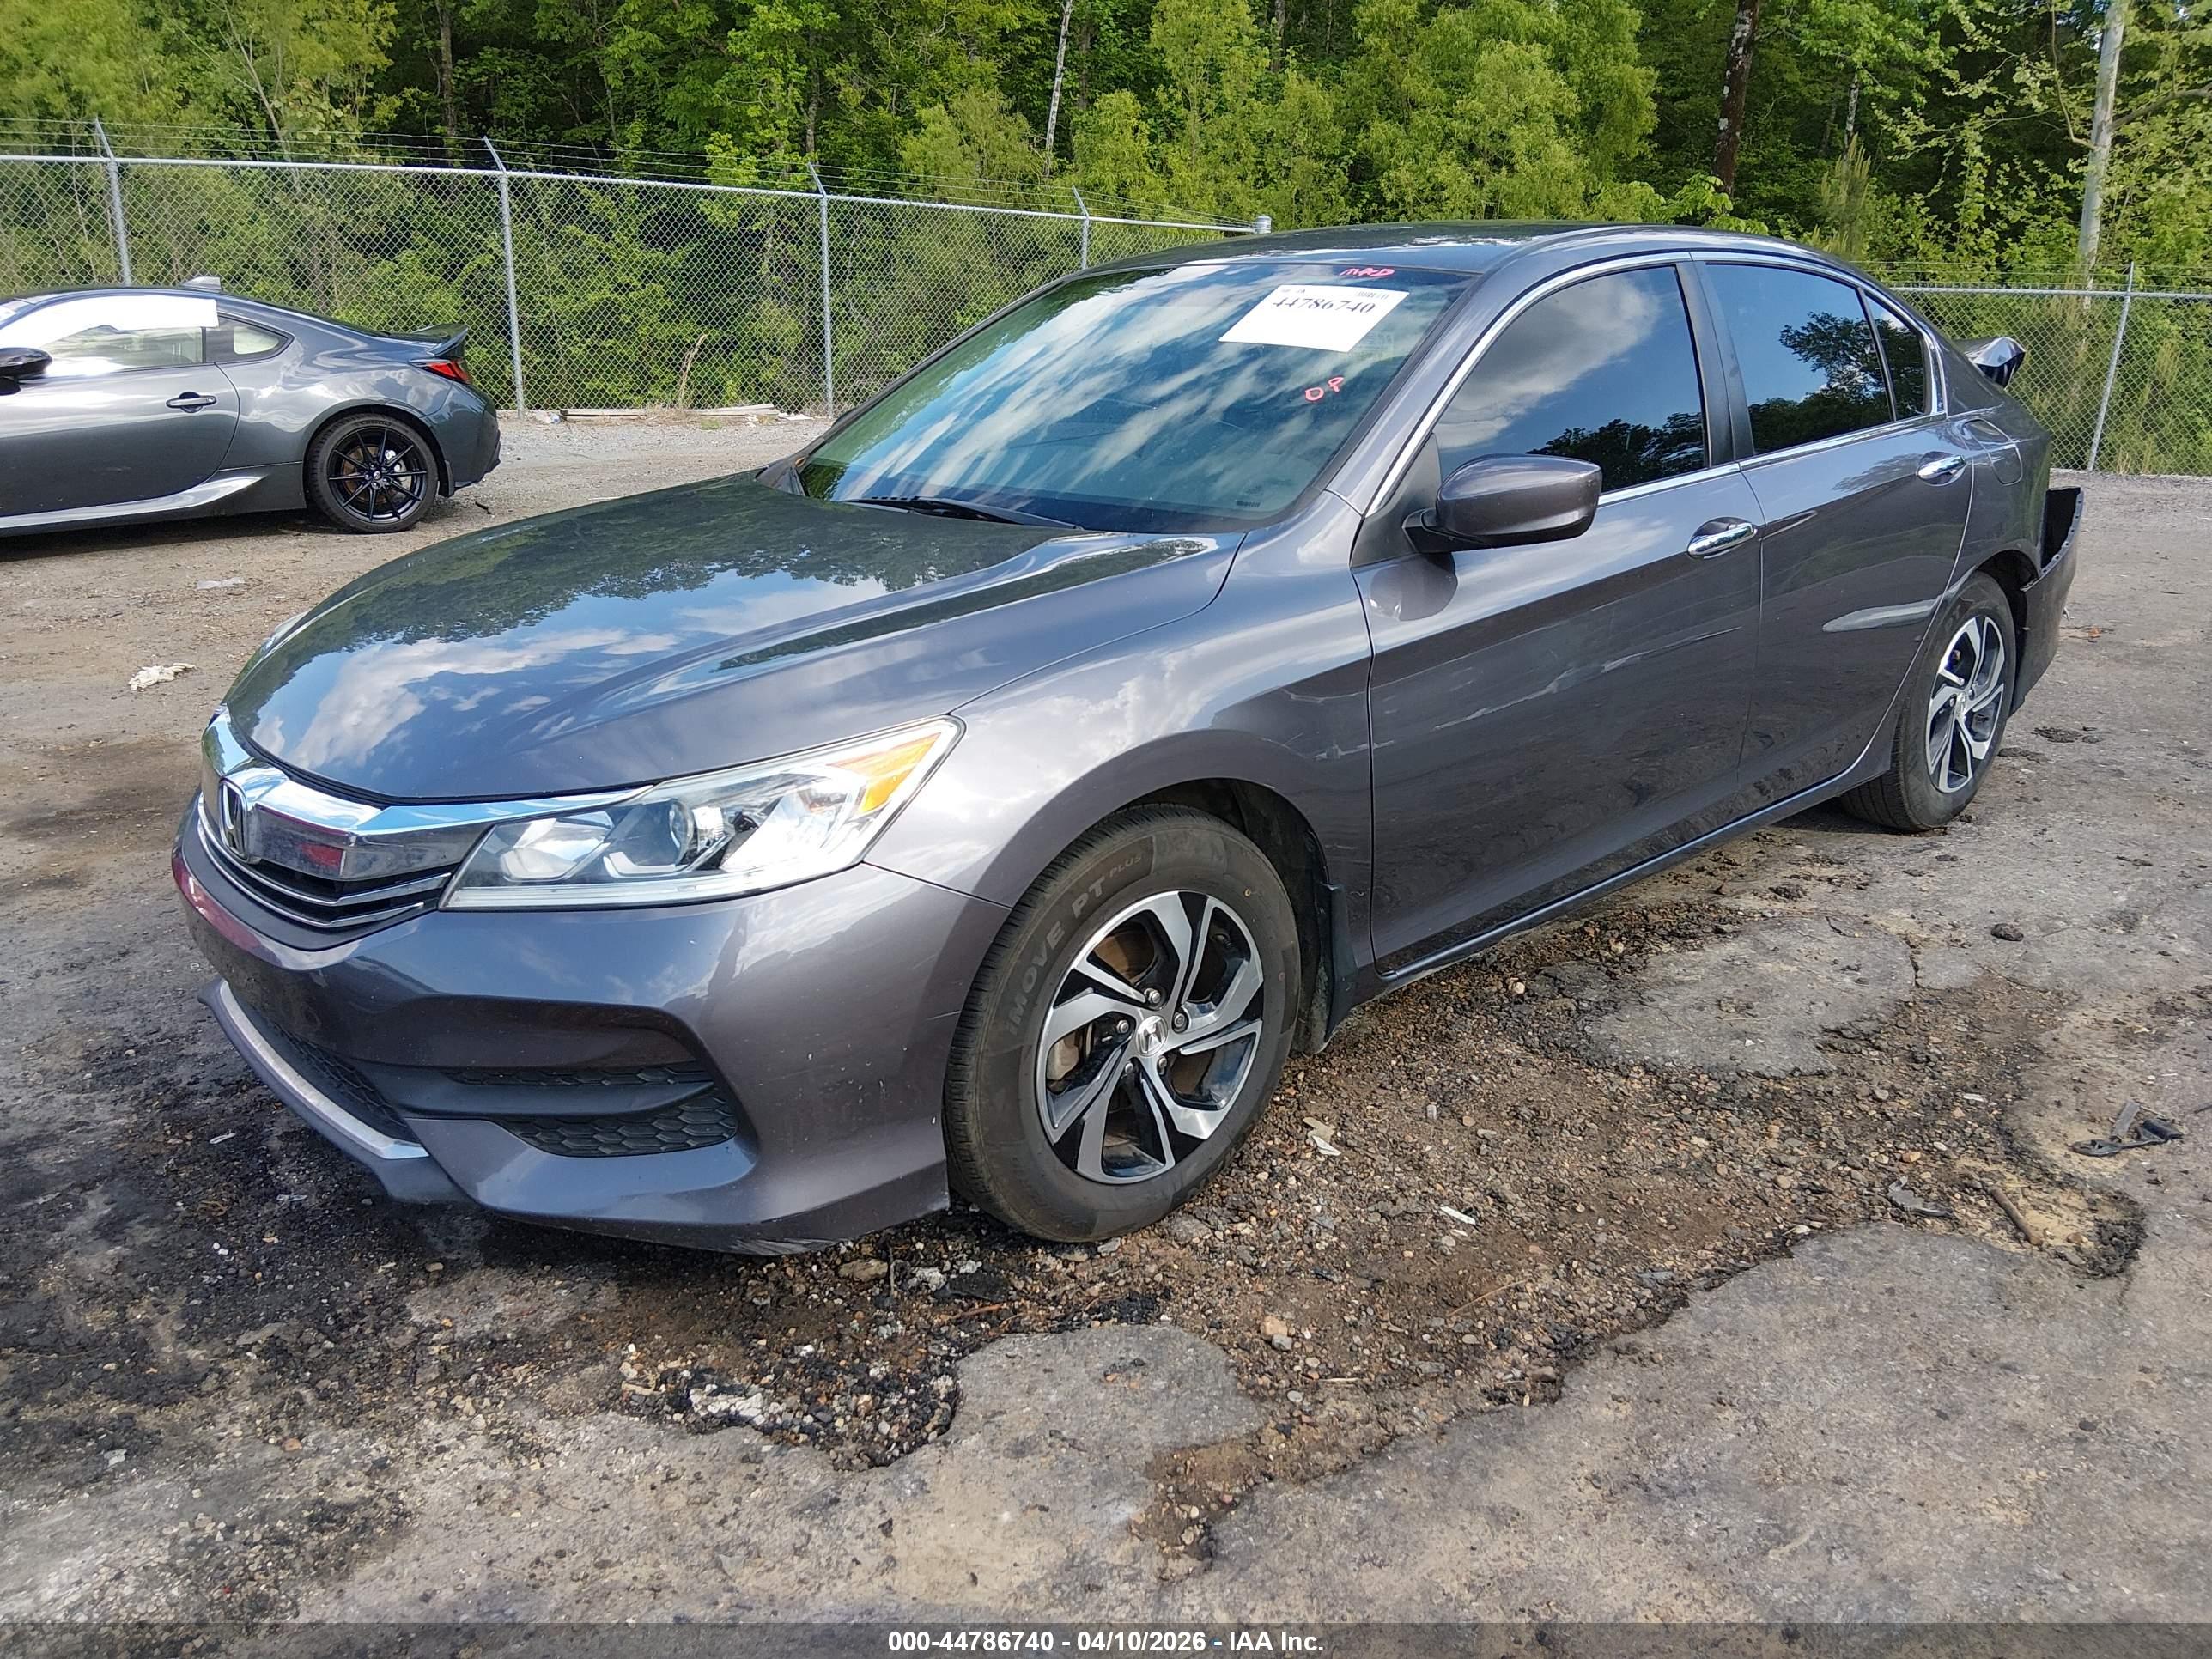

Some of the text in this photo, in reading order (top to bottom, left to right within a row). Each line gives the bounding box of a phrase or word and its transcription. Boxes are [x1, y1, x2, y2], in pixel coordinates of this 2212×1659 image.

[1273, 297, 1376, 313] 44786740
[1072, 877, 1106, 918] PT
[1109, 854, 1142, 878] PLUS
